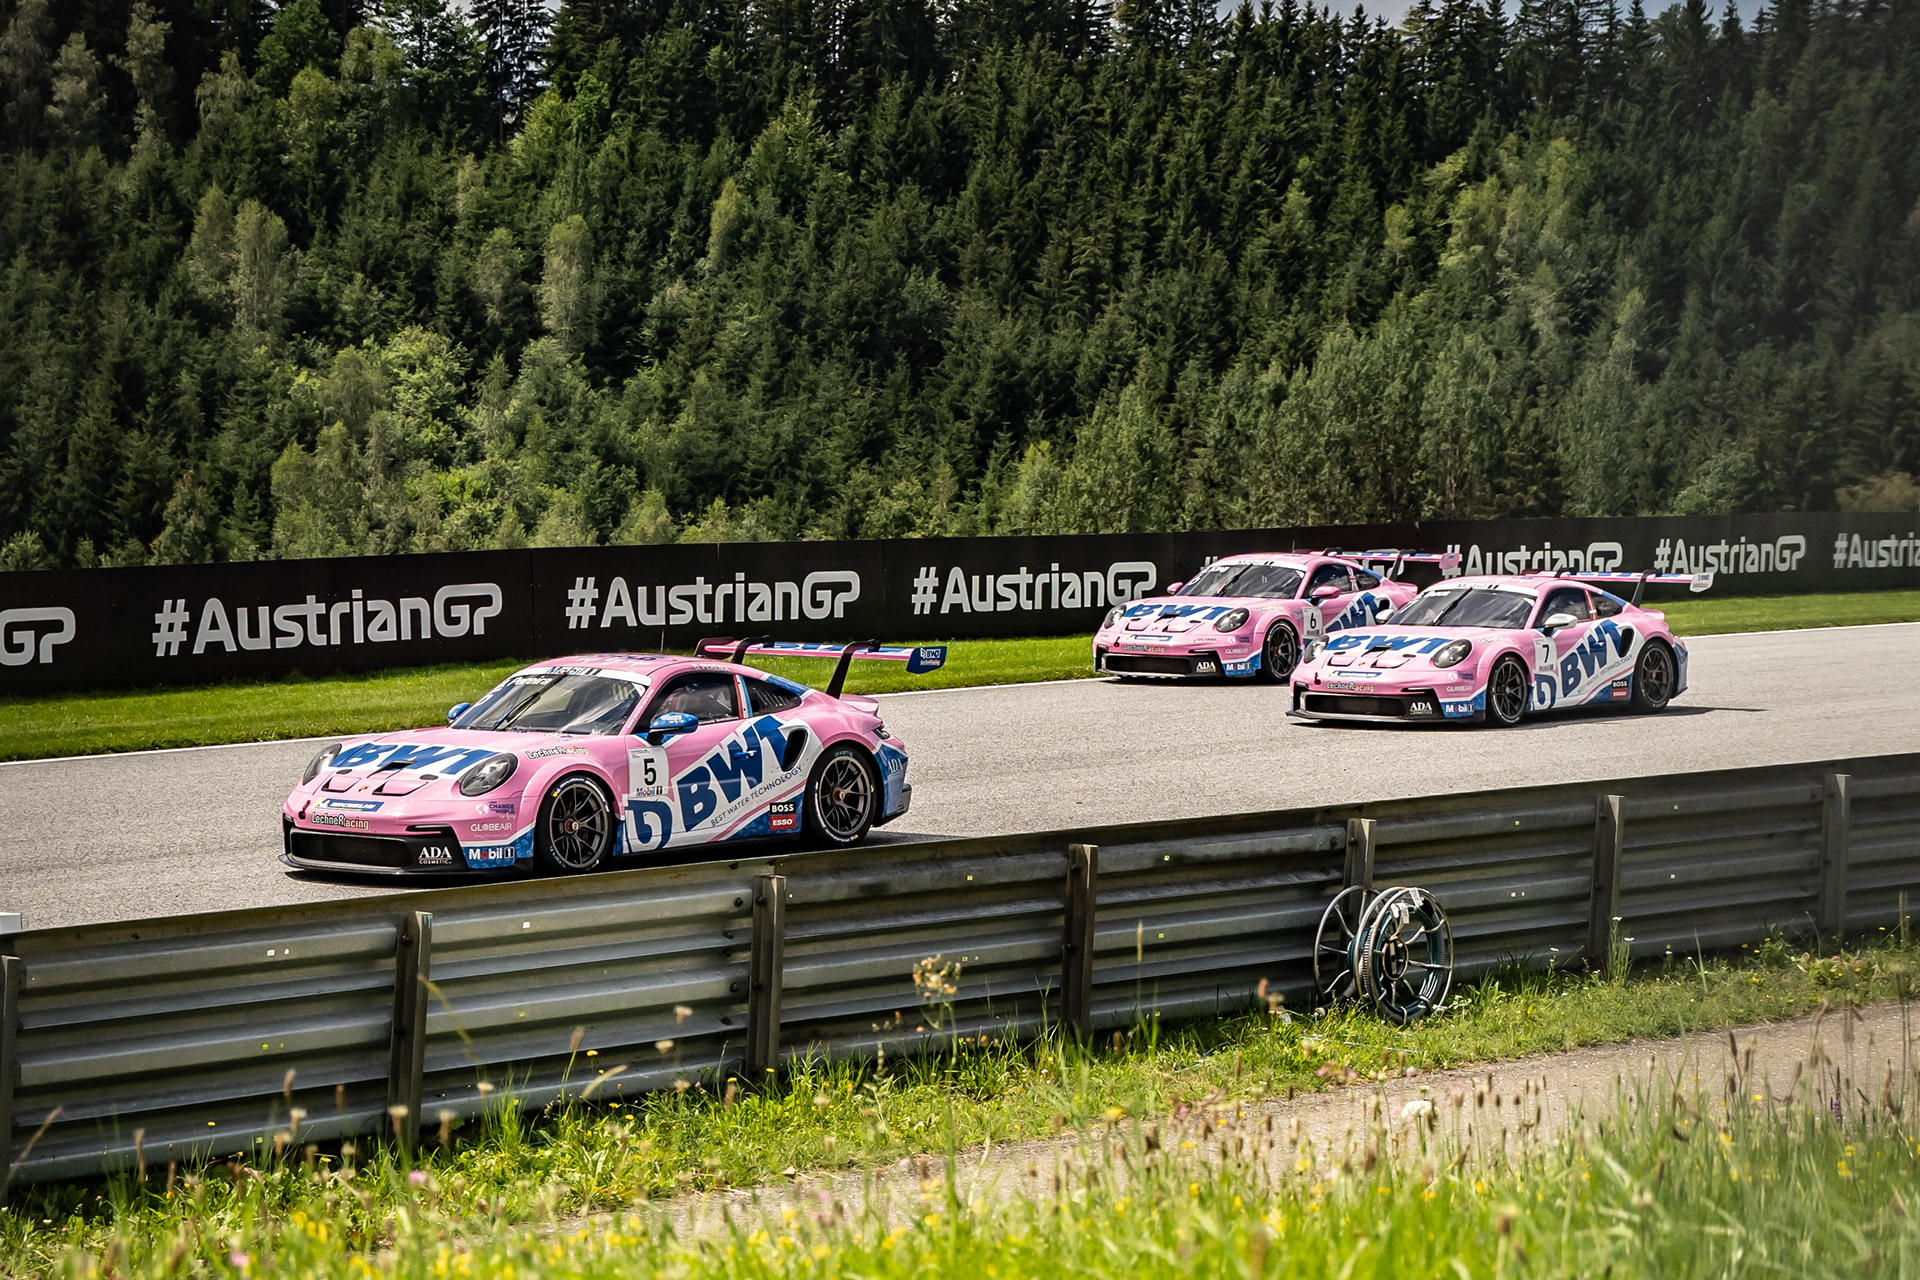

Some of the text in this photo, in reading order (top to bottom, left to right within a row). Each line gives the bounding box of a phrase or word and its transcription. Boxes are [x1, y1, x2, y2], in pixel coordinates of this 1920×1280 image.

[1653, 535, 1806, 575] #AustrianGP
[911, 561, 1157, 615] #AustrianGP
[565, 570, 861, 629] #AustrianGP
[152, 582, 502, 657] #AustrianGP
[1123, 604, 1234, 620] BWT
[1310, 613, 1317, 629] 6
[1324, 635, 1453, 654] BWT
[1542, 644, 1550, 663] 7
[1560, 619, 1621, 697] BWT
[1197, 661, 1216, 669] ADA
[1410, 702, 1433, 711] ADA
[1445, 704, 1468, 713] Mobil
[328, 743, 503, 775] BWT
[643, 758, 657, 785] 5
[677, 715, 788, 832] BWT
[636, 787, 655, 797] Mobil
[711, 765, 802, 827] BEST WATER TECHNOLOGY
[771, 804, 794, 813] BOSS
[470, 822, 513, 832] GLOBEAIR
[772, 818, 793, 827] ESSO
[419, 846, 452, 859] ADA
[468, 847, 503, 860] Mobil
